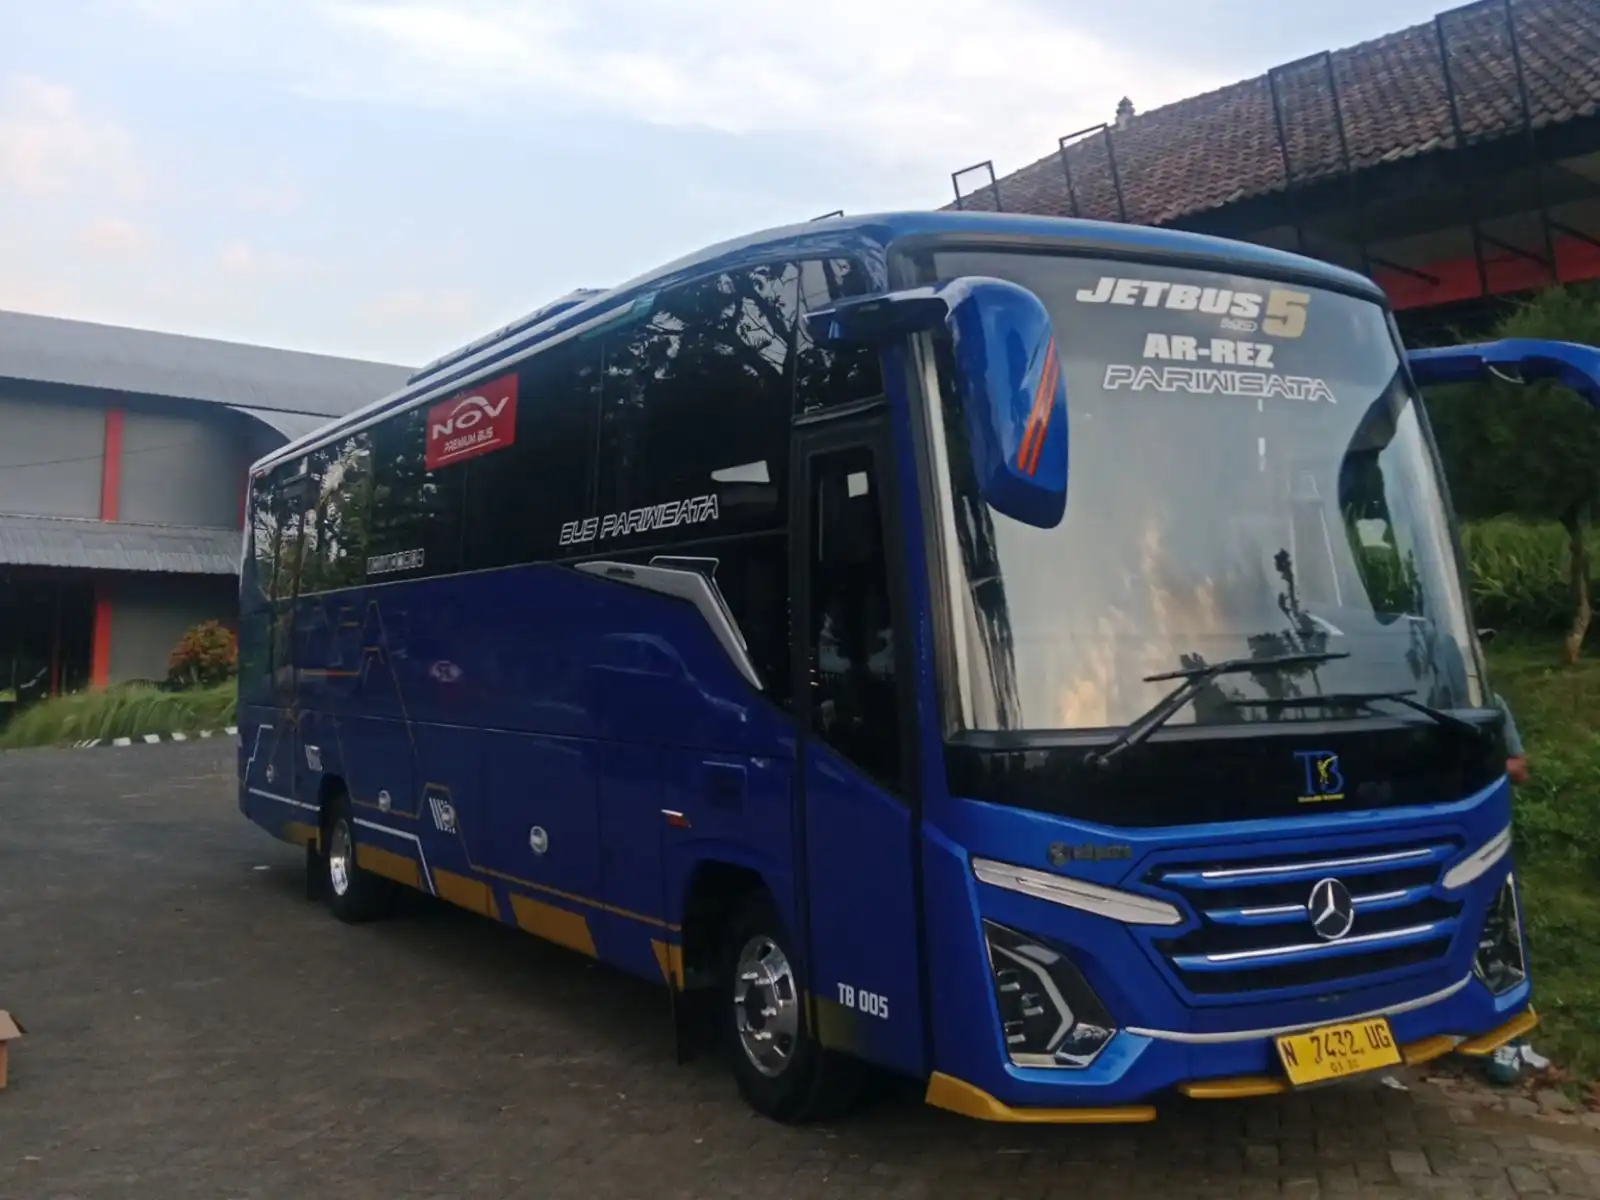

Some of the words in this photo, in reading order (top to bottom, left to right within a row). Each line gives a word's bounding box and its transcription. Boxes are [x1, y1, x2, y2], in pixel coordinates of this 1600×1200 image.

[1076, 277, 1263, 318] JETBUS
[1262, 288, 1311, 338] 5
[1143, 333, 1274, 368] AR-REZ
[1103, 365, 1337, 404] PARIWISATA
[477, 426, 494, 442] BUS
[559, 517, 599, 545] BUS
[600, 494, 719, 539] PARIWISATA
[837, 982, 855, 1008] TB
[859, 990, 889, 1019] 005
[1282, 1040, 1298, 1067] N
[1309, 1029, 1360, 1064] 7432
[1364, 1024, 1392, 1049] UG
